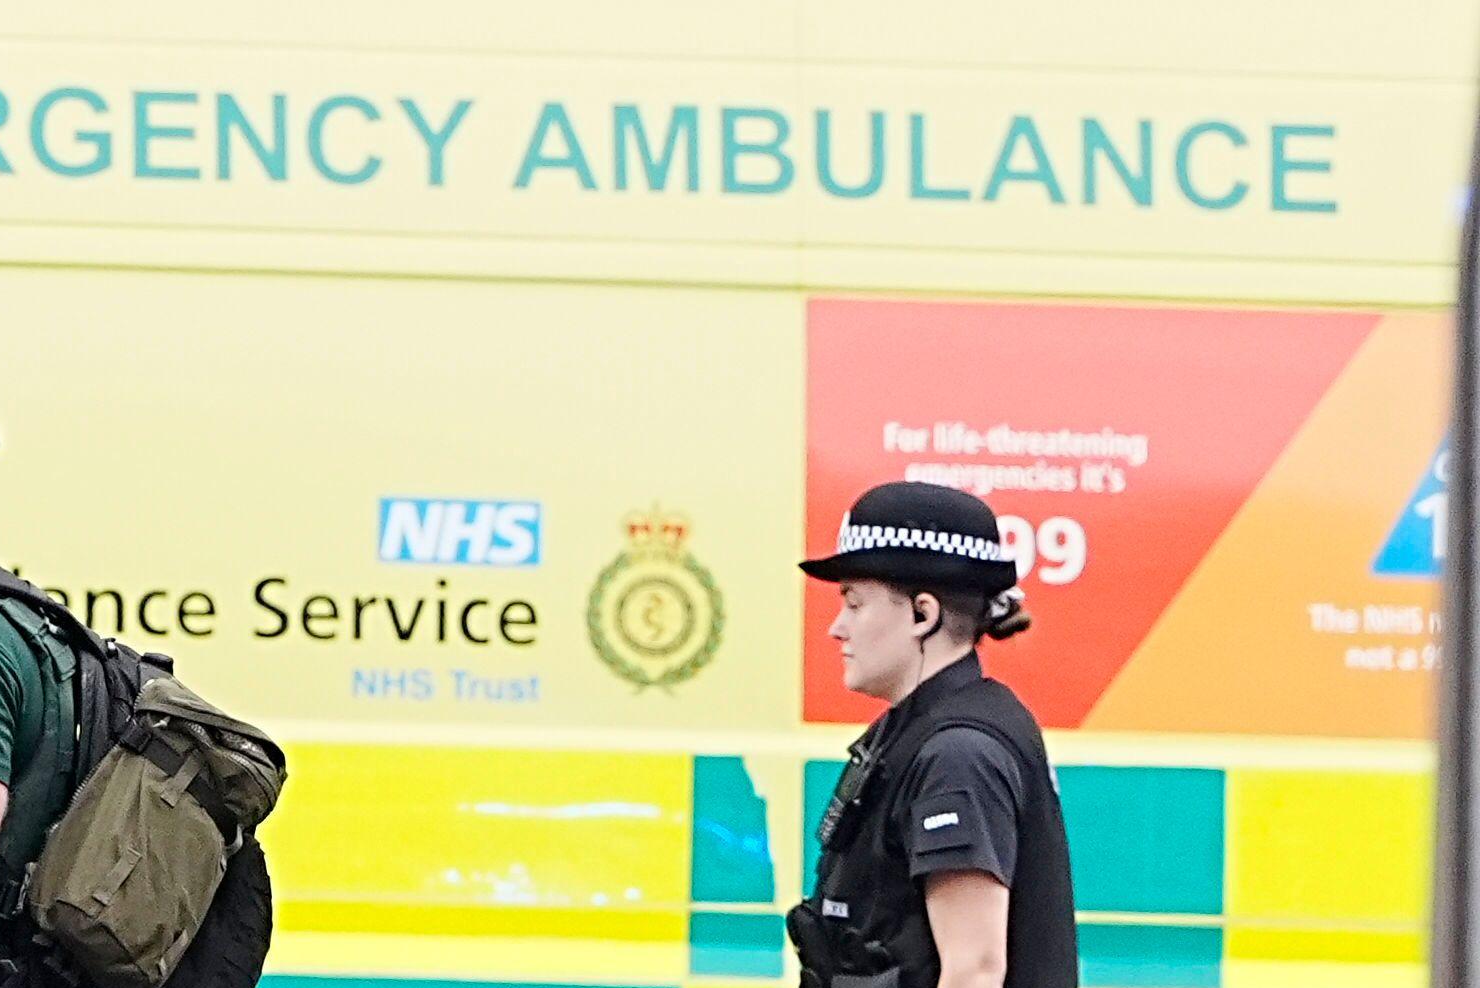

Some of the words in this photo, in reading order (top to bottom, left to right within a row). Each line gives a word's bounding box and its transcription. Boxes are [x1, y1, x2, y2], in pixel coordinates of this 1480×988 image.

[513, 102, 1338, 213] AMBULANCE
[883, 421, 929, 452] For
[933, 422, 1148, 466] life-threatening
[905, 463, 1076, 495] emergencies
[1080, 461, 1126, 493] it's
[380, 500, 539, 564] NHS
[254, 578, 537, 645] Service
[1309, 603, 1360, 634] The
[1362, 605, 1424, 635] NHS
[1345, 646, 1394, 670] not
[1396, 649, 1419, 671] a
[352, 670, 434, 699] NHS
[451, 670, 540, 702] Trust
